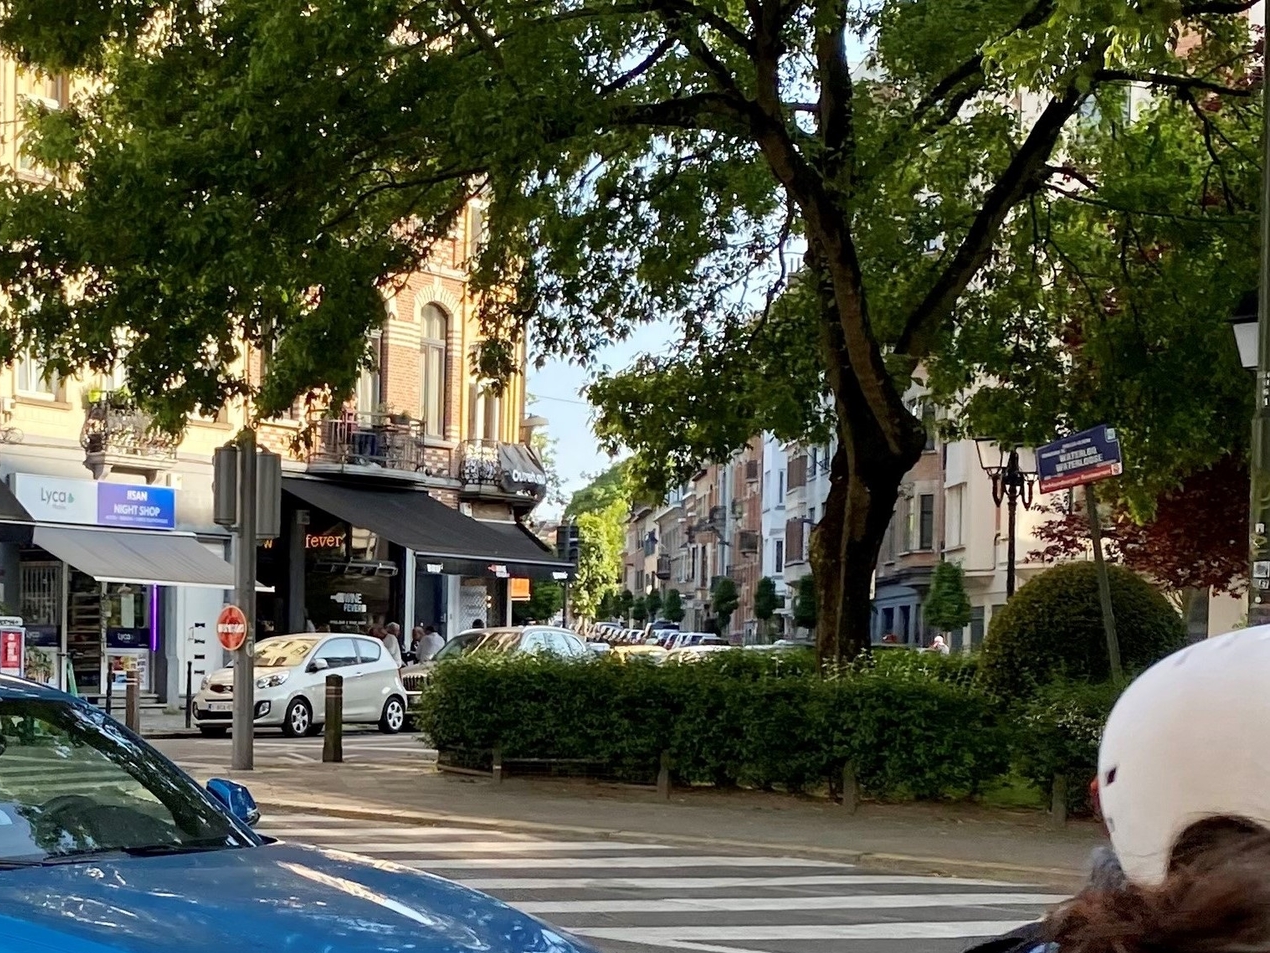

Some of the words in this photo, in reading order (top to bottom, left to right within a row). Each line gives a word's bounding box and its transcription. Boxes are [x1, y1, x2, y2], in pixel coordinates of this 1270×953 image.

[40, 487, 66, 505] Lyca
[113, 504, 139, 516] NIGHT
[139, 506, 161, 517] SHOP
[304, 534, 343, 548] fever
